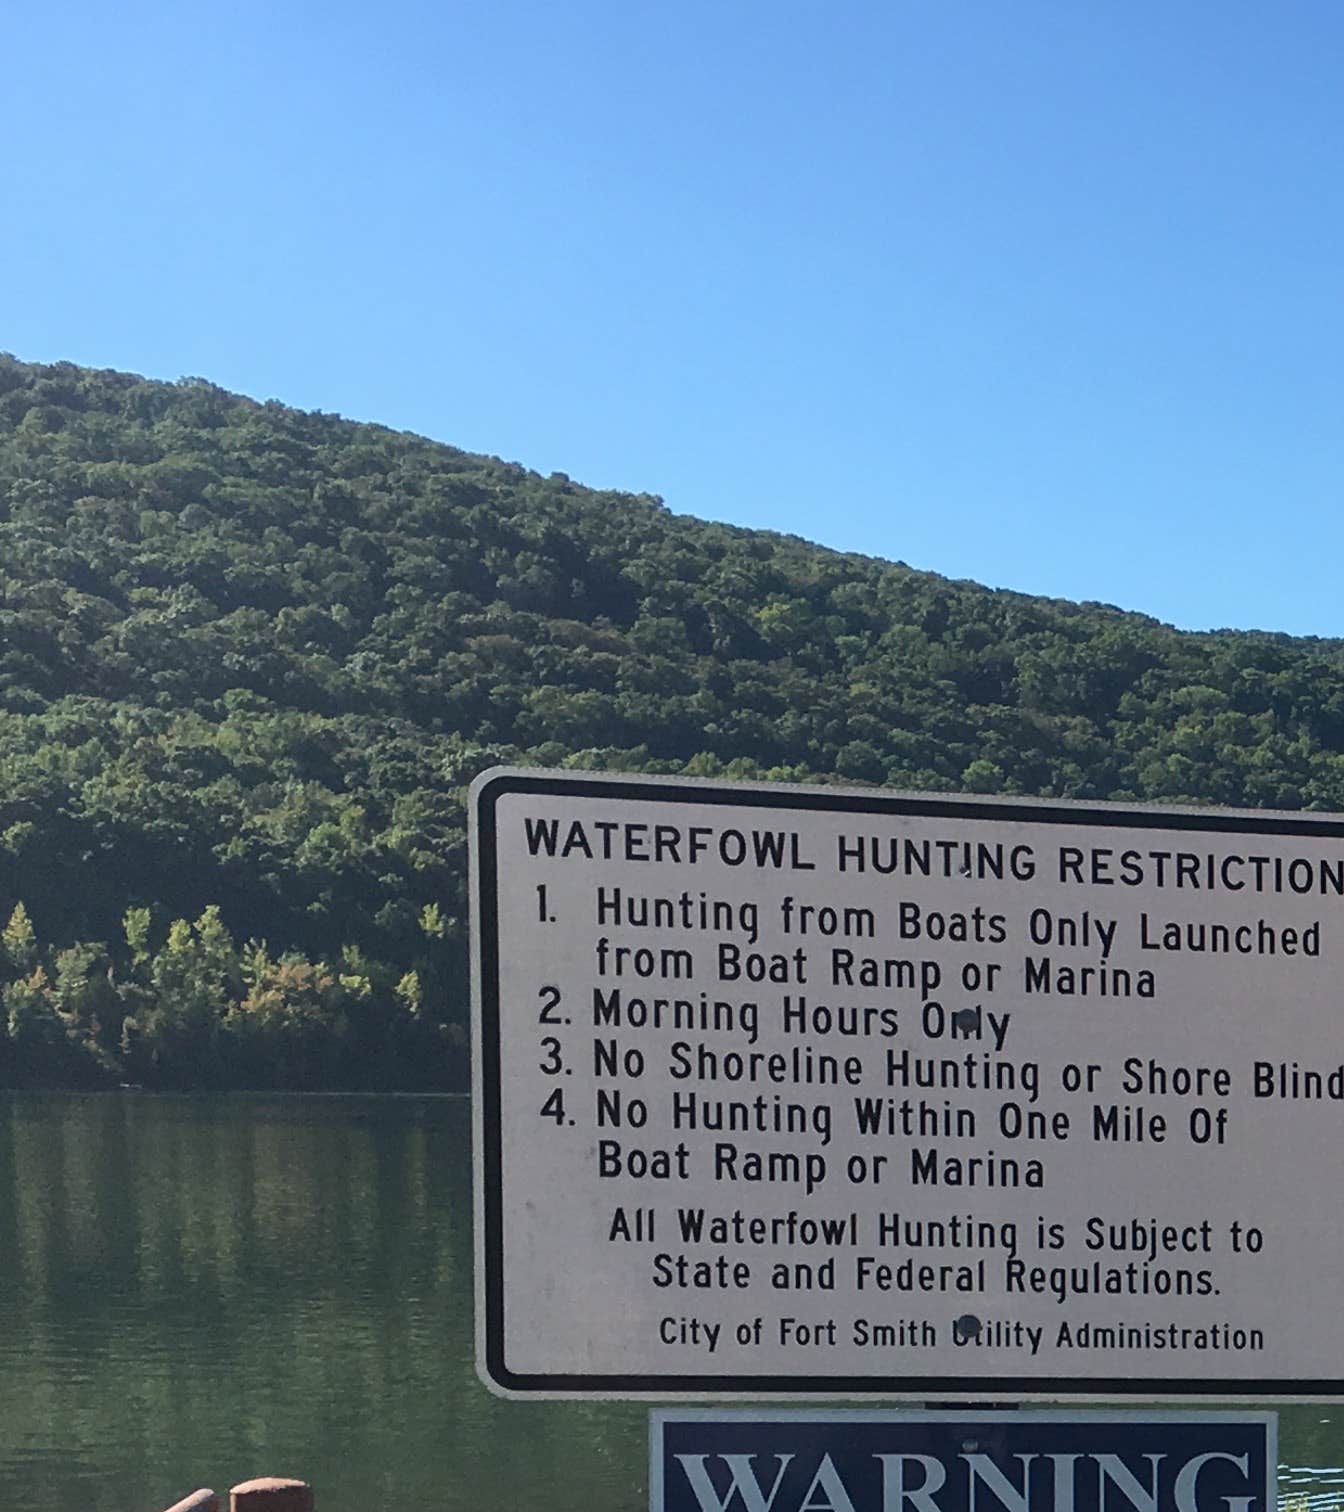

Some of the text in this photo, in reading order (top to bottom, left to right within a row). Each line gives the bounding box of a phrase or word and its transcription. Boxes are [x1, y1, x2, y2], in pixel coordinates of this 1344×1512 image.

[525, 818, 815, 870] WATERFOWL
[839, 835, 1035, 881] HUNTING
[537, 884, 1319, 958] 1. Hunting from Boats Only Launched
[596, 937, 1154, 1002] from Boat Ramp or Marina
[539, 986, 571, 1025] 2.
[593, 988, 758, 1044] Morning
[784, 996, 898, 1037] Hours
[540, 1037, 572, 1075] 3.
[594, 1039, 644, 1078] No
[669, 1042, 862, 1085] Shoreline
[887, 1049, 1038, 1103] Hunting
[1062, 1064, 1101, 1092] or
[1123, 1058, 1231, 1096] Shore
[540, 1088, 1227, 1146] 4. No Hunting Within One Mile Of
[599, 1140, 1043, 1195] Boat Ramp or Marina
[609, 1207, 1263, 1262] All Waterfowl Hunting is Subject to
[653, 1253, 1222, 1302] State and Federal Regulations.
[660, 1317, 720, 1352] City
[737, 1318, 762, 1345] of
[780, 1318, 836, 1346] Fort
[853, 1319, 936, 1347] Smith
[1056, 1321, 1263, 1350] Administration
